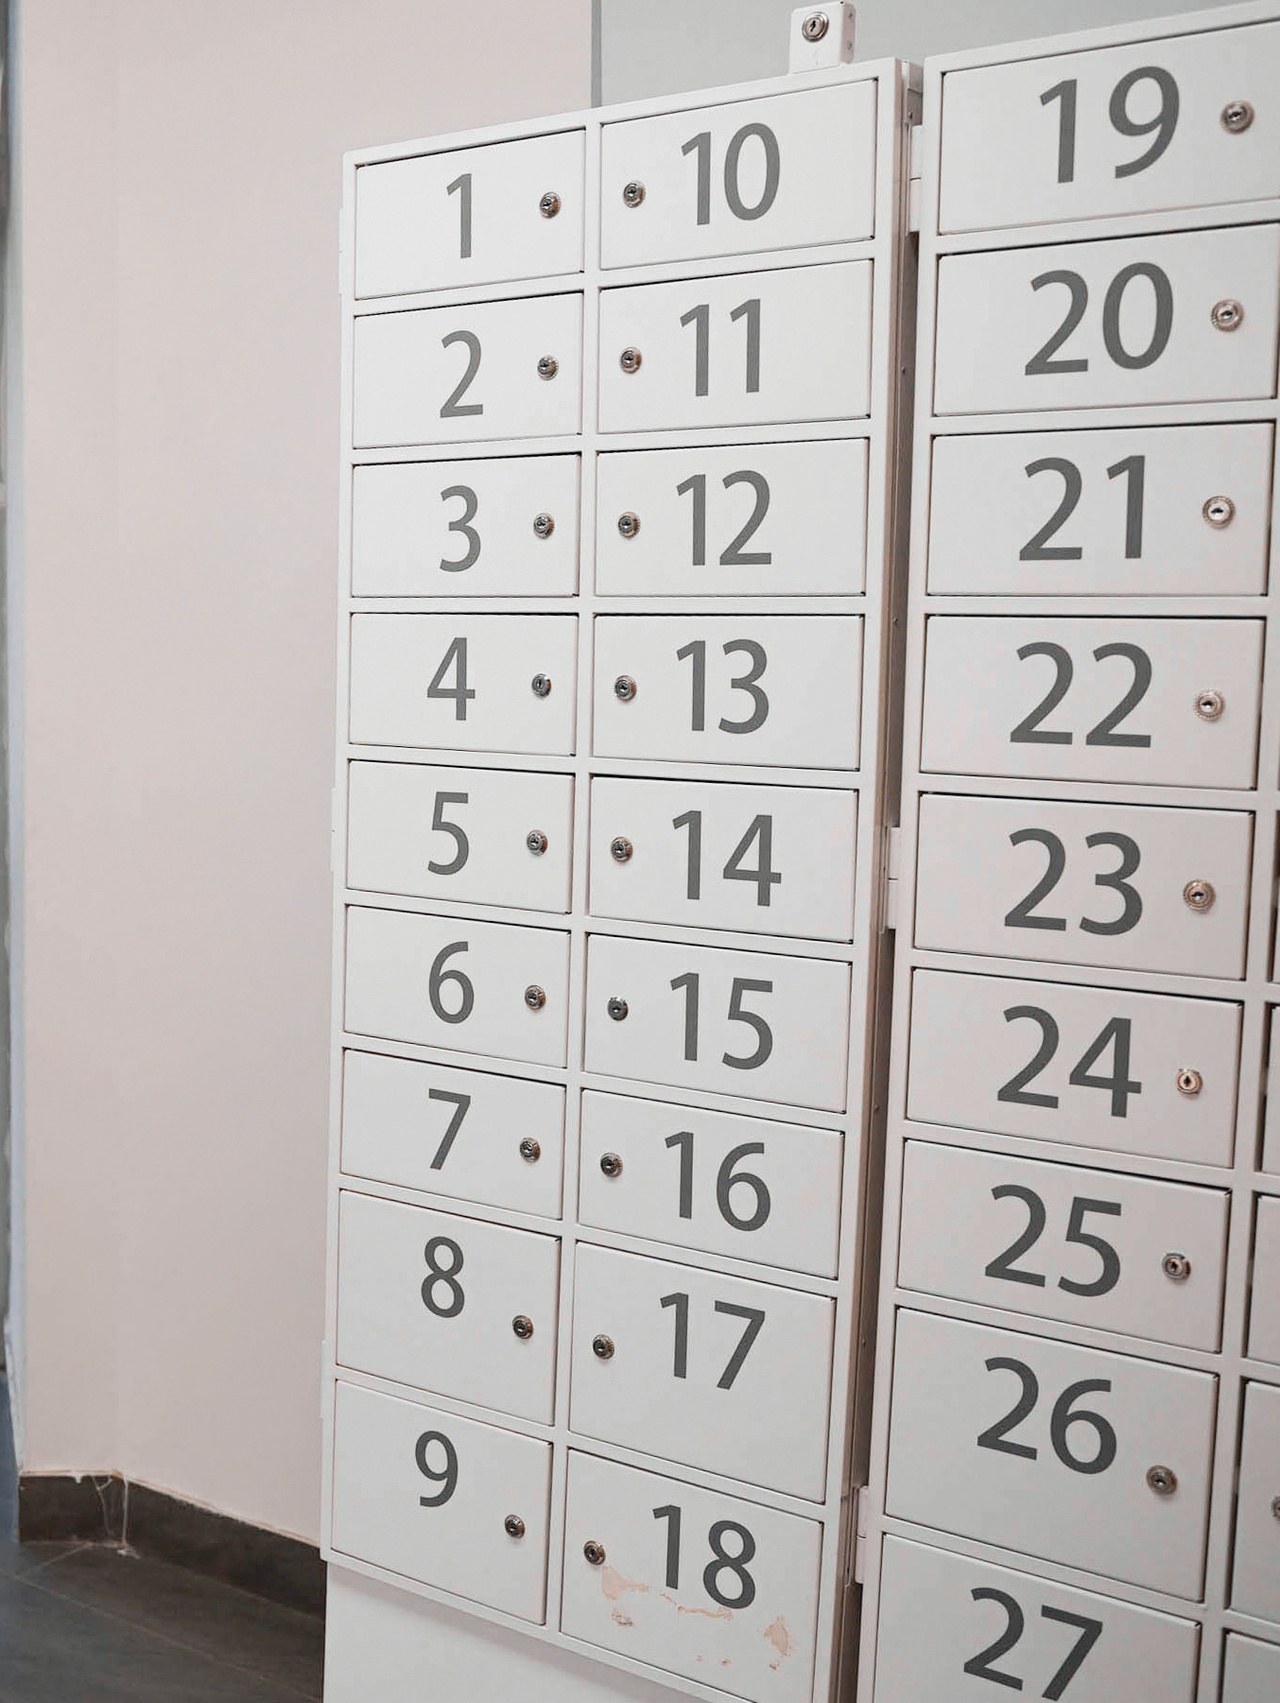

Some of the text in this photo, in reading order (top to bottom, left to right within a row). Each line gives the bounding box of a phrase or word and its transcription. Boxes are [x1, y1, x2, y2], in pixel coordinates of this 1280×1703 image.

[681, 122, 780, 226] 10
[1039, 65, 1180, 184] 19
[446, 173, 472, 259] 1
[679, 298, 761, 397] 11
[1024, 261, 1174, 376] 20
[440, 330, 484, 418] 2
[439, 485, 481, 573] 3
[676, 470, 772, 566] 12
[1018, 454, 1146, 561] 21
[426, 637, 476, 721] 4
[676, 638, 770, 735] 13
[1009, 641, 1153, 749] 22
[427, 791, 470, 876] 5
[672, 810, 782, 907] 14
[1003, 827, 1144, 937] 23
[428, 940, 475, 1024] 6
[669, 972, 774, 1071] 15
[996, 1005, 1143, 1119] 24
[428, 1088, 472, 1171] 7
[664, 1131, 772, 1232] 16
[420, 1235, 465, 1319] 8
[984, 1183, 1122, 1298] 25
[659, 1291, 766, 1391] 17
[976, 1356, 1118, 1475] 26
[414, 1430, 459, 1508] 9
[652, 1504, 757, 1610] 18
[963, 1586, 1104, 1703] 27
